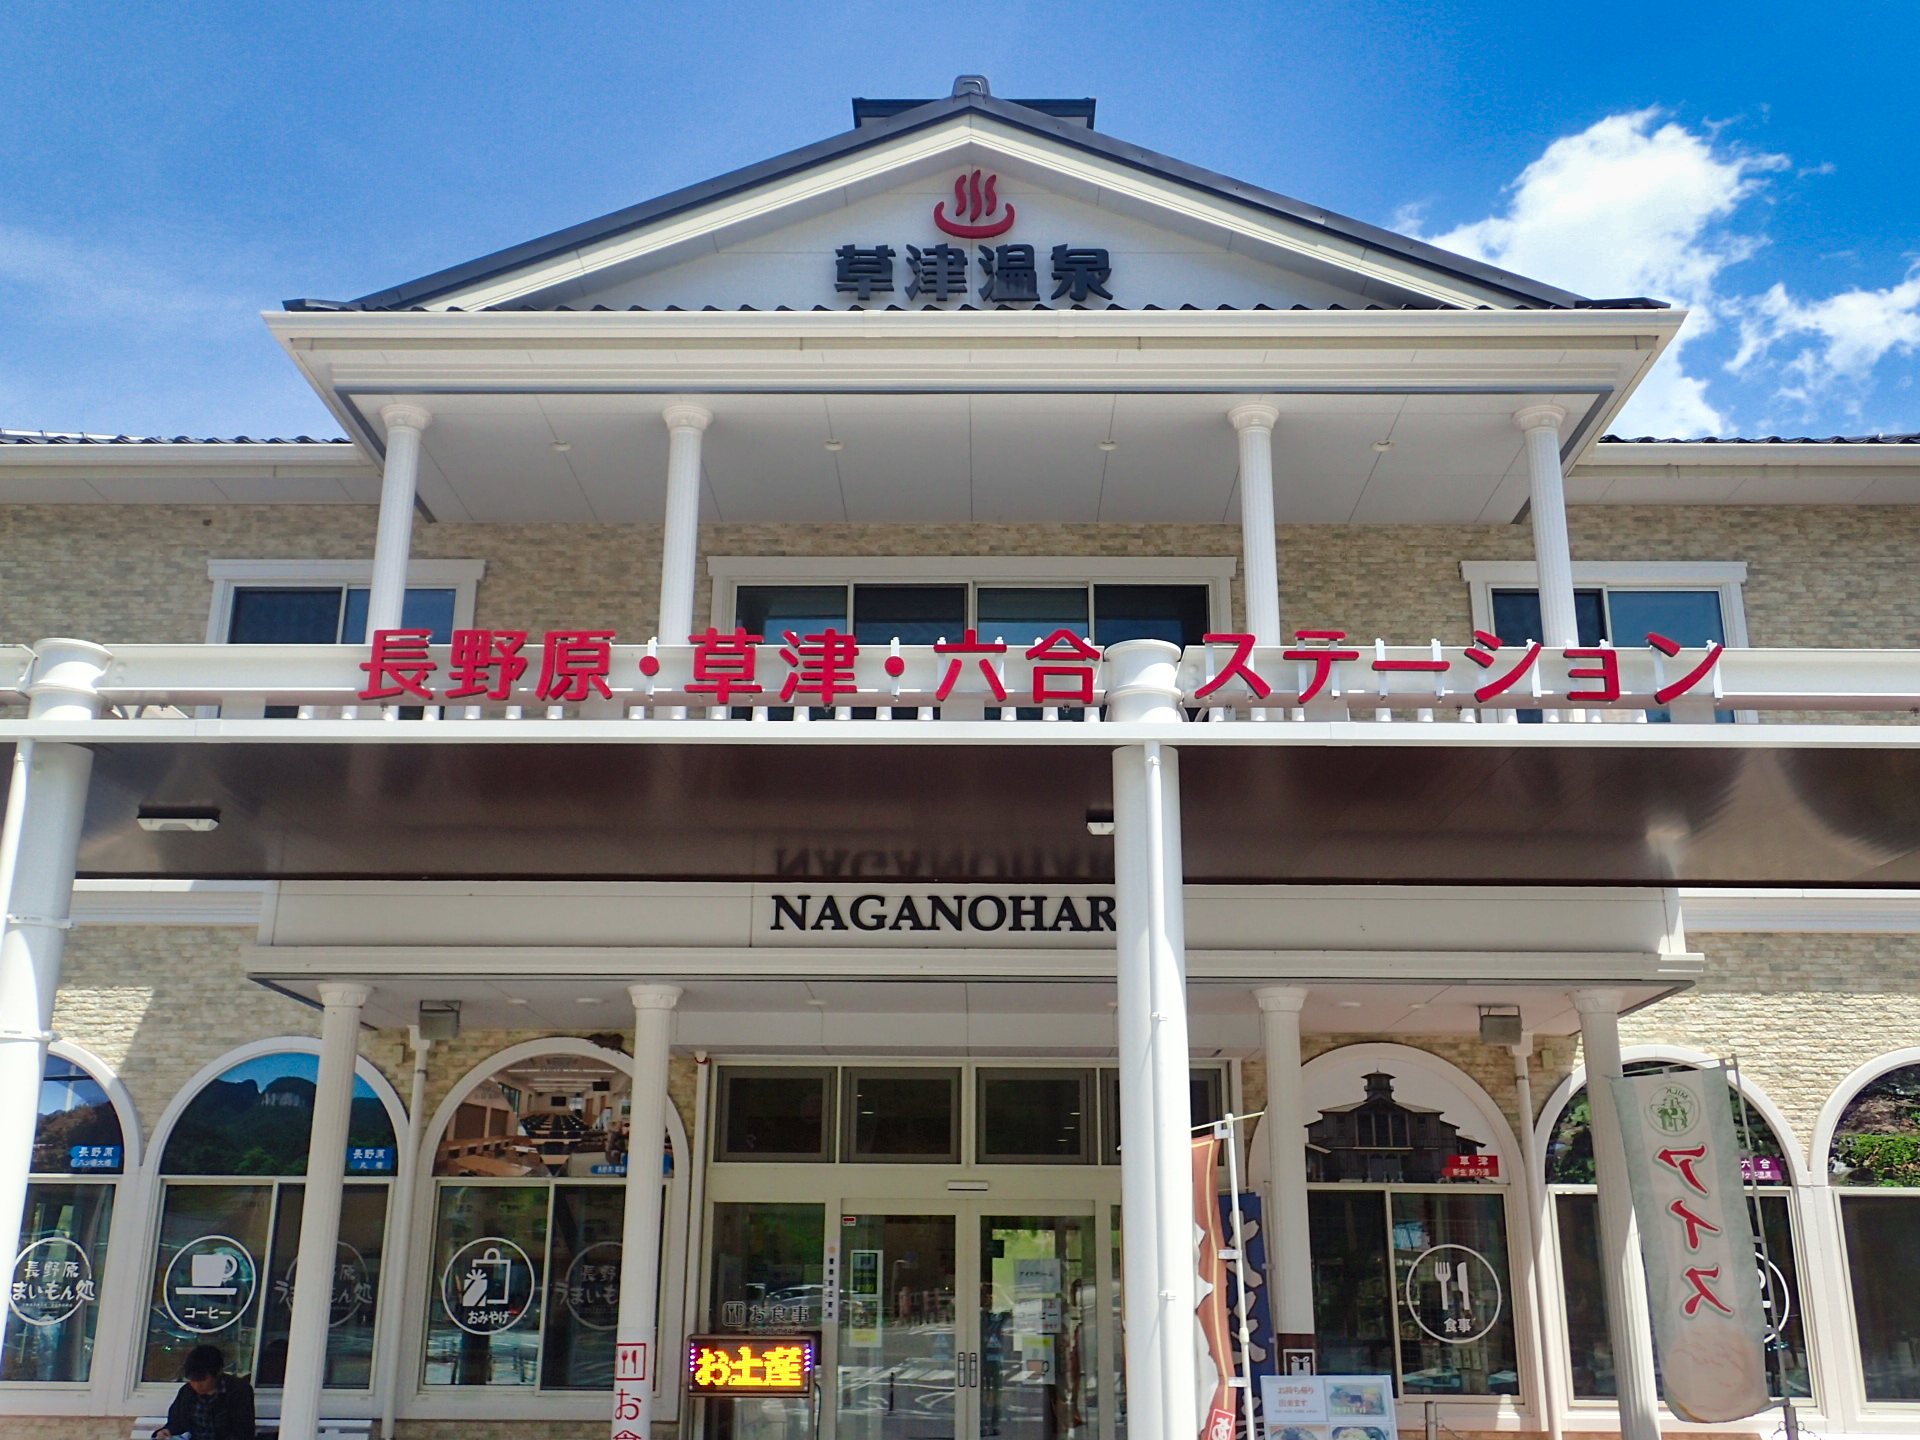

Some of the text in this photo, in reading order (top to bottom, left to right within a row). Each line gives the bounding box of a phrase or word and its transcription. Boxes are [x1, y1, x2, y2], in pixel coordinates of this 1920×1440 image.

[834, 243, 1114, 302] 草津温泉
[770, 894, 1117, 932] NAGANOHAR
[78, 1146, 115, 1158] 長野原
[352, 1148, 386, 1160] 長野原
[1740, 1158, 1771, 1169] 六合
[24, 1260, 80, 1278] 長野原
[580, 1265, 618, 1282] 長野
[12, 1279, 96, 1301] まいもん処
[553, 1281, 619, 1306] うまいも
[183, 1305, 232, 1320] コーヒー
[467, 1310, 511, 1325] おみやげ
[749, 1304, 810, 1323] お食事
[1443, 1317, 1472, 1333] 食事
[694, 1344, 803, 1387] お土産
